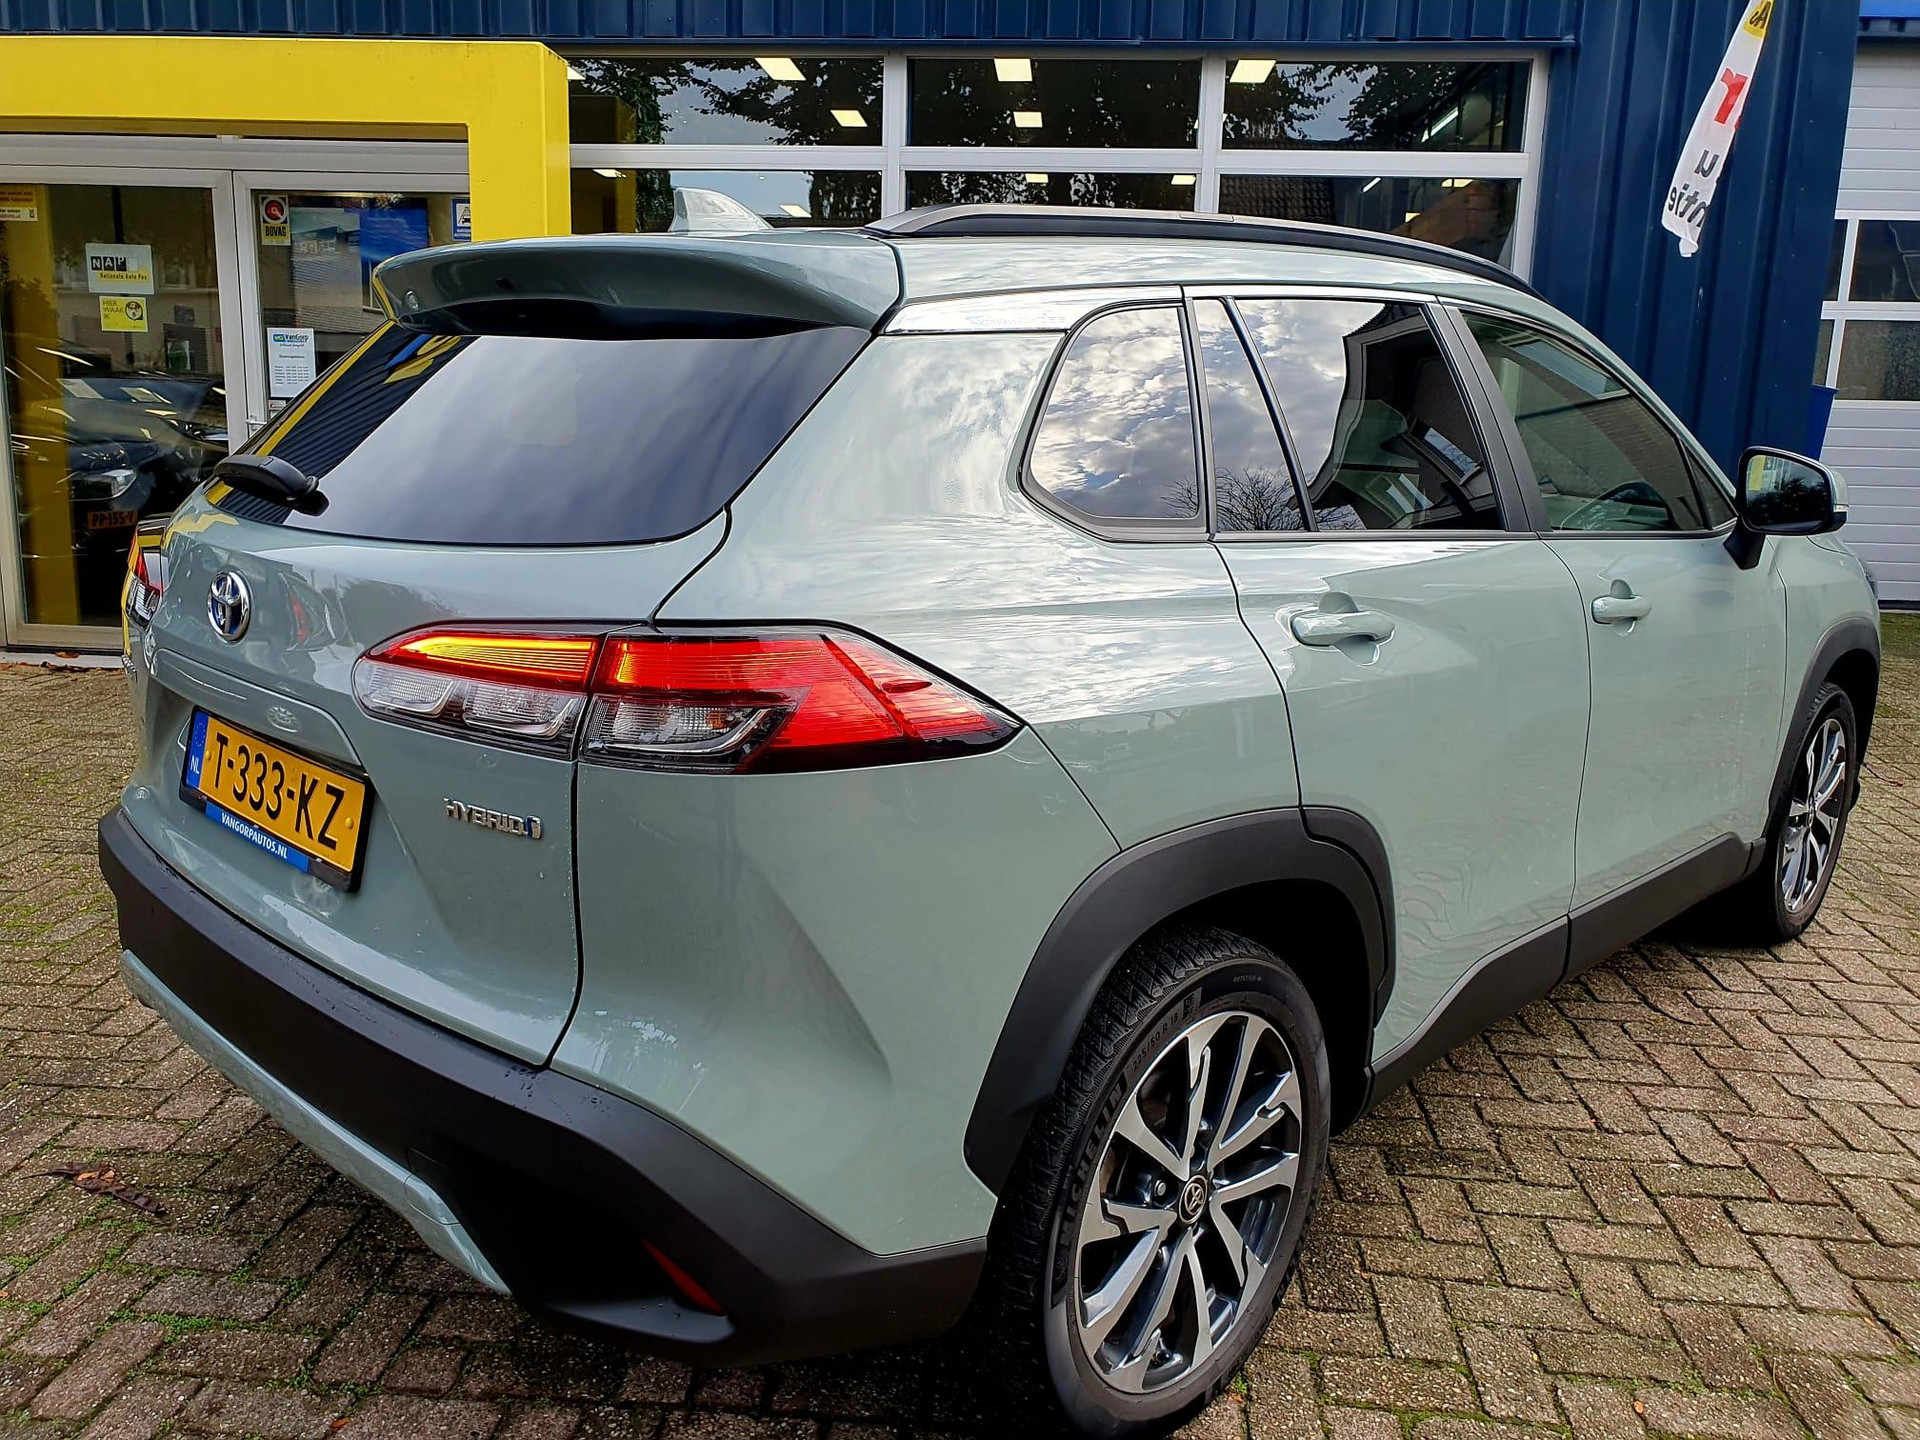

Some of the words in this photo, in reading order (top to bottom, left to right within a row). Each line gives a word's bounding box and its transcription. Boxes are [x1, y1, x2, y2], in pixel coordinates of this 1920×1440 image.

[265, 225, 287, 237] BOVAG
[92, 256, 125, 269] NAP
[285, 334, 309, 342] VanGorp
[190, 755, 200, 775] NL
[215, 732, 346, 851] T-333-KZ
[443, 797, 525, 835] HYBRID
[221, 812, 288, 859] VANGORPAUTOS.NL
[1059, 1085, 1125, 1248] MICHELIN
